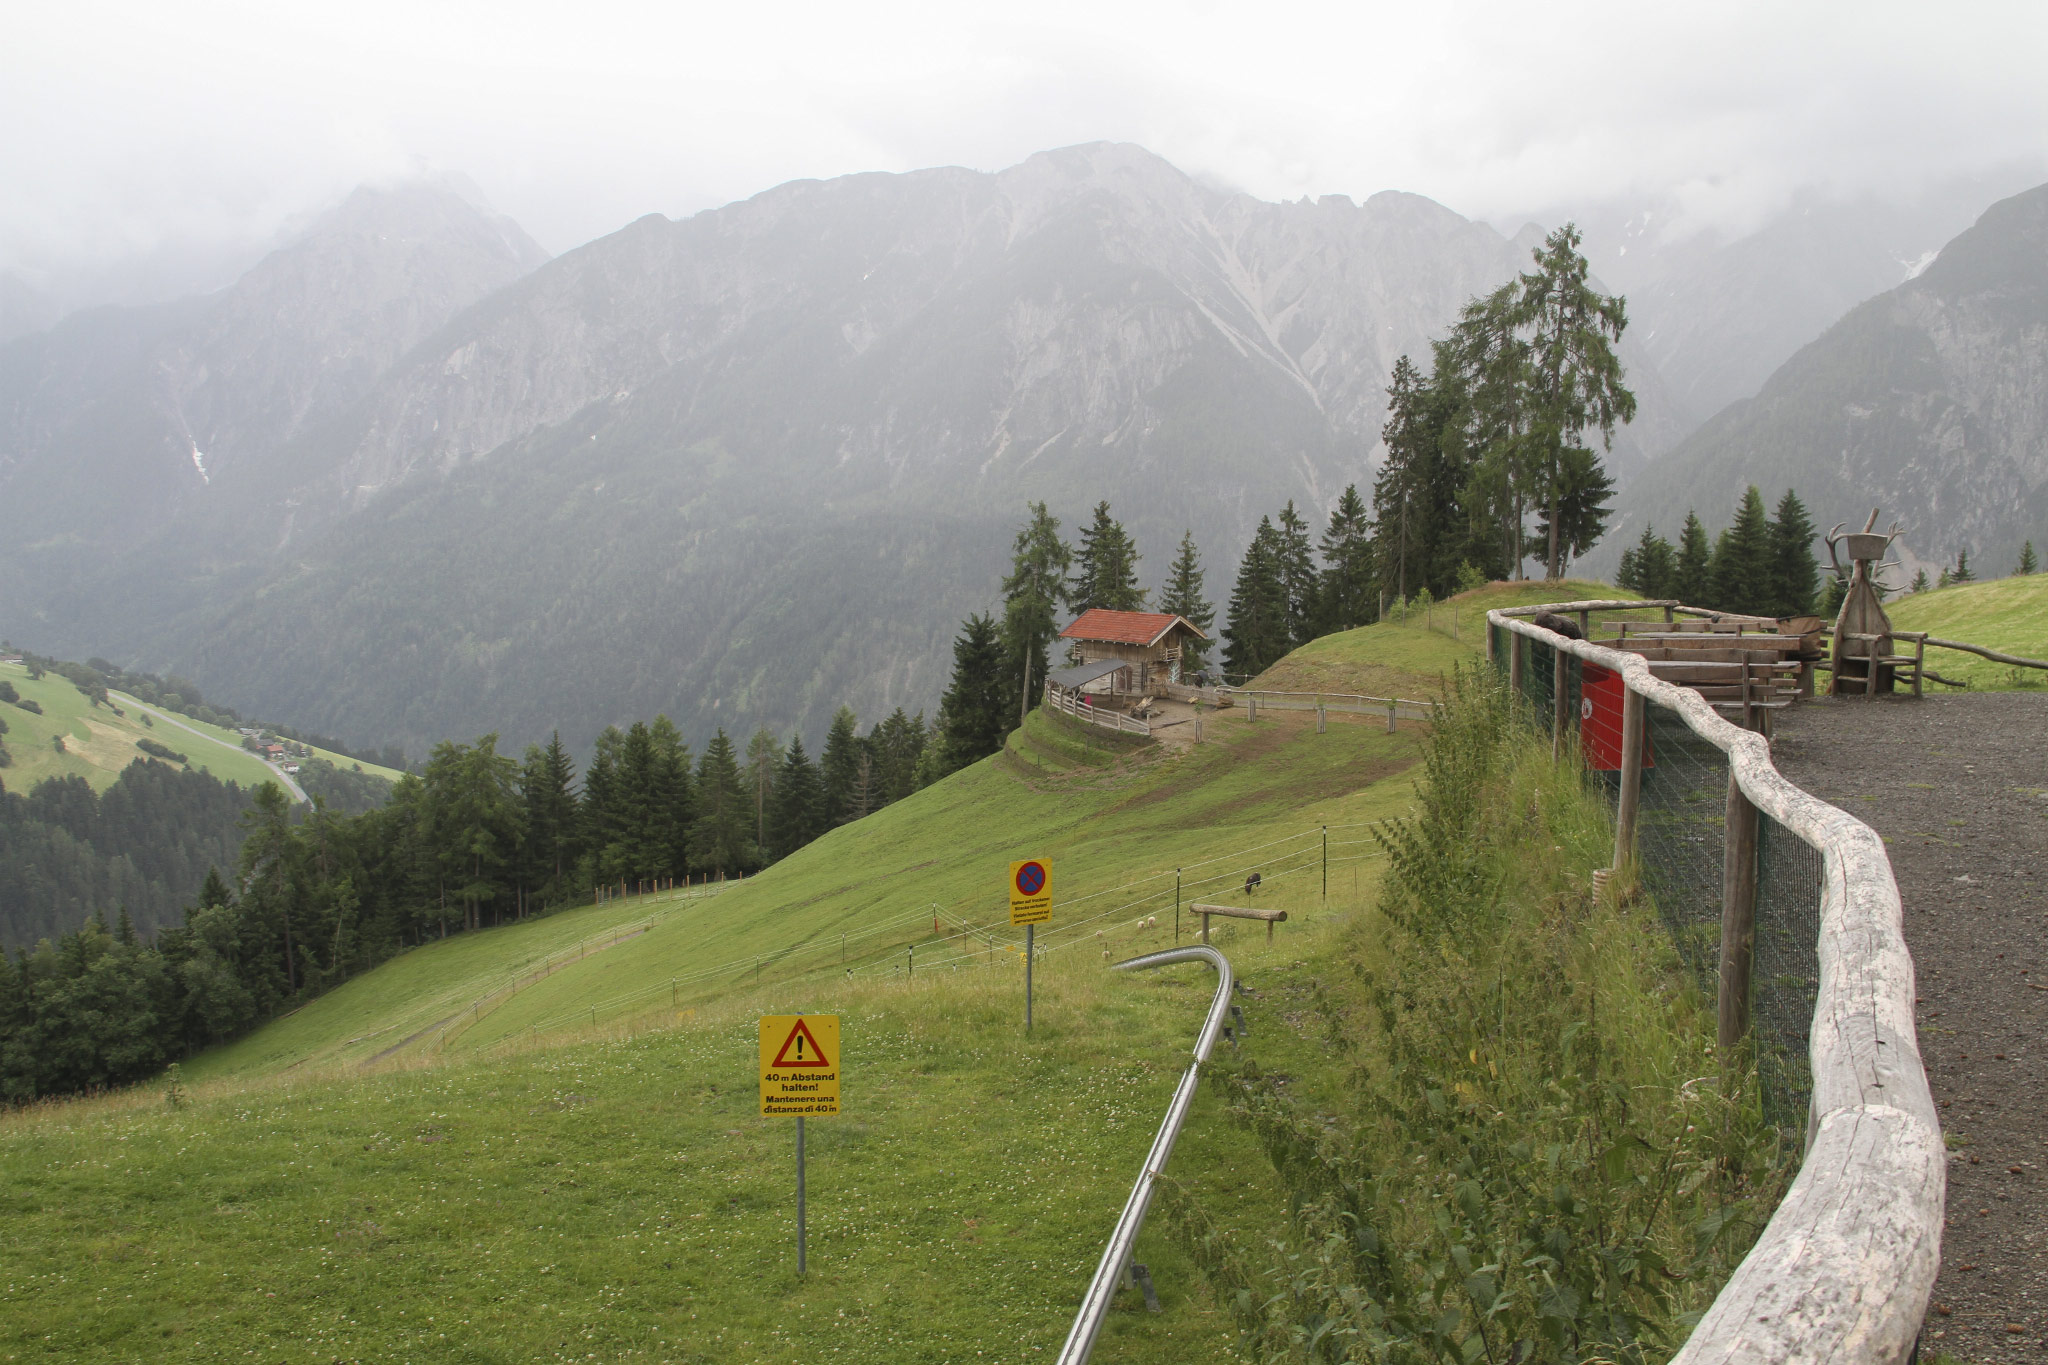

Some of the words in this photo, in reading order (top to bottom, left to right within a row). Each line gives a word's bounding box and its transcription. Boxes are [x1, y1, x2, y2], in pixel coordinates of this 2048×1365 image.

[765, 1073, 780, 1081] 40
[791, 1073, 835, 1081] Abstand
[781, 1083, 819, 1091] halten!
[764, 1105, 803, 1113] distanza
